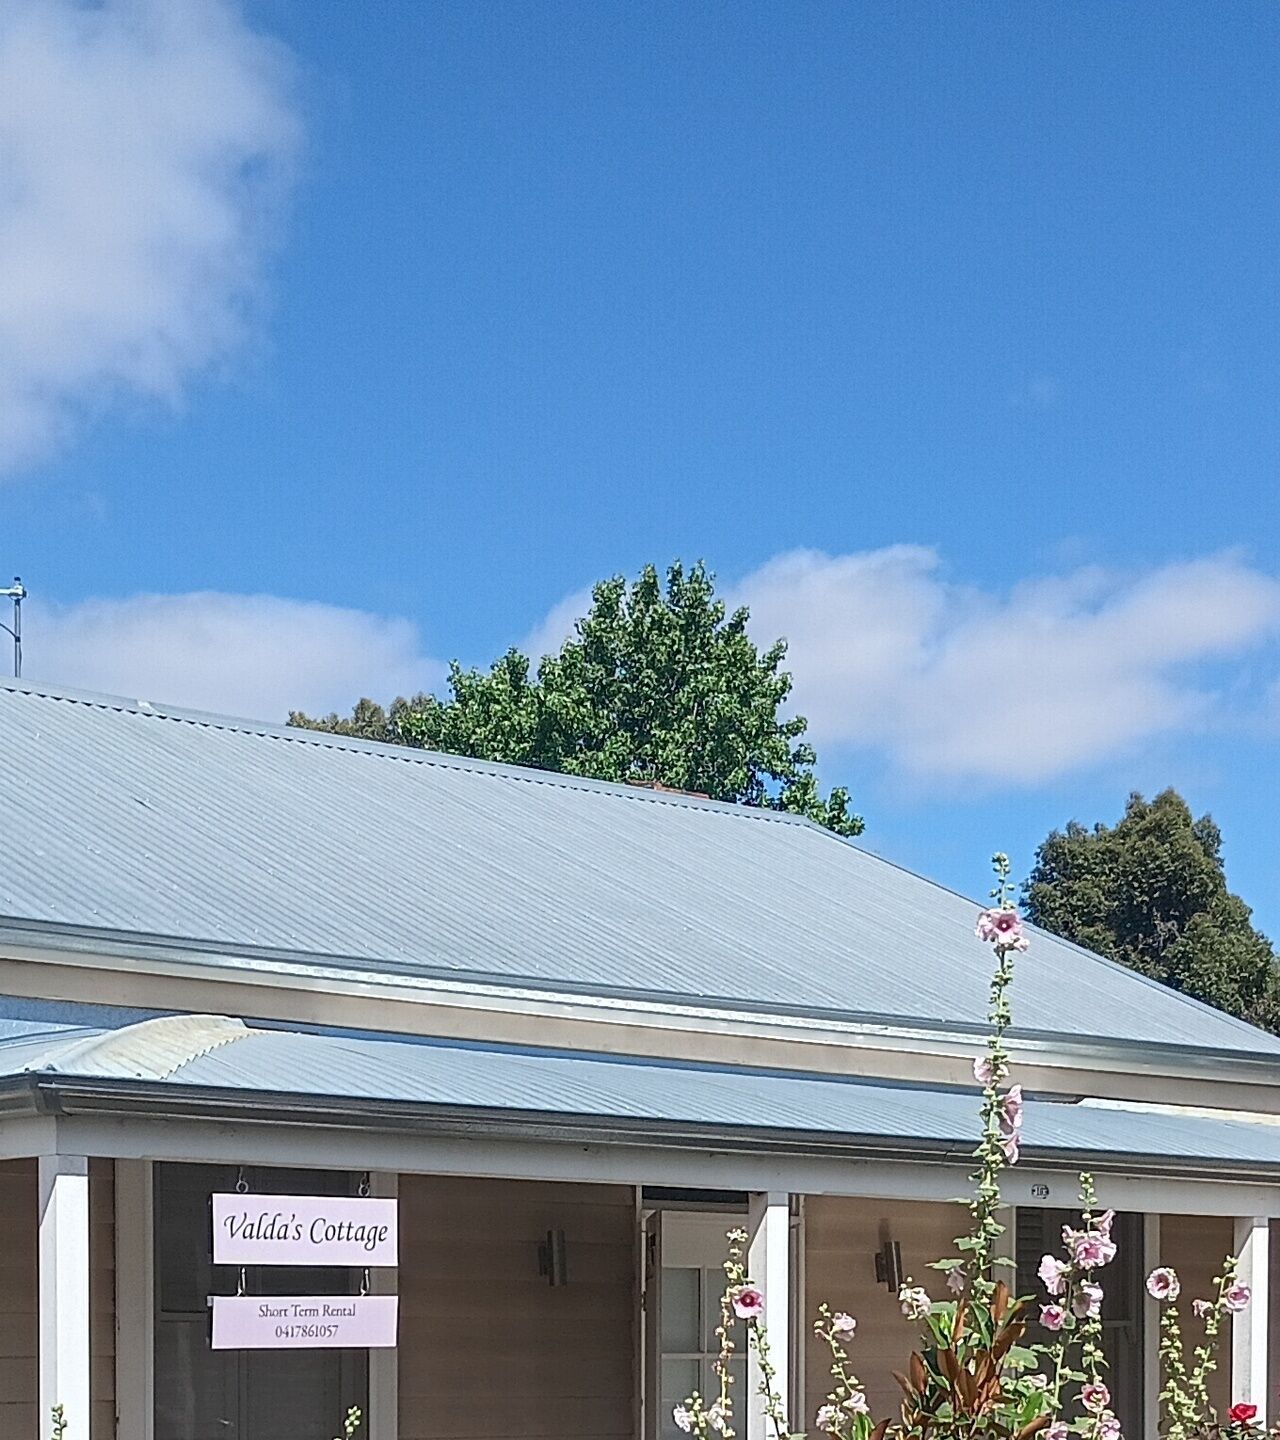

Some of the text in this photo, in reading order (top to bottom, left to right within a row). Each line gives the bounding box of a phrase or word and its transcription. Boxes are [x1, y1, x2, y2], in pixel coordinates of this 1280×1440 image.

[223, 1212, 389, 1252] Valda's Cottage
[258, 1304, 356, 1318] Short Term Rental
[275, 1324, 339, 1338] 0417861057
